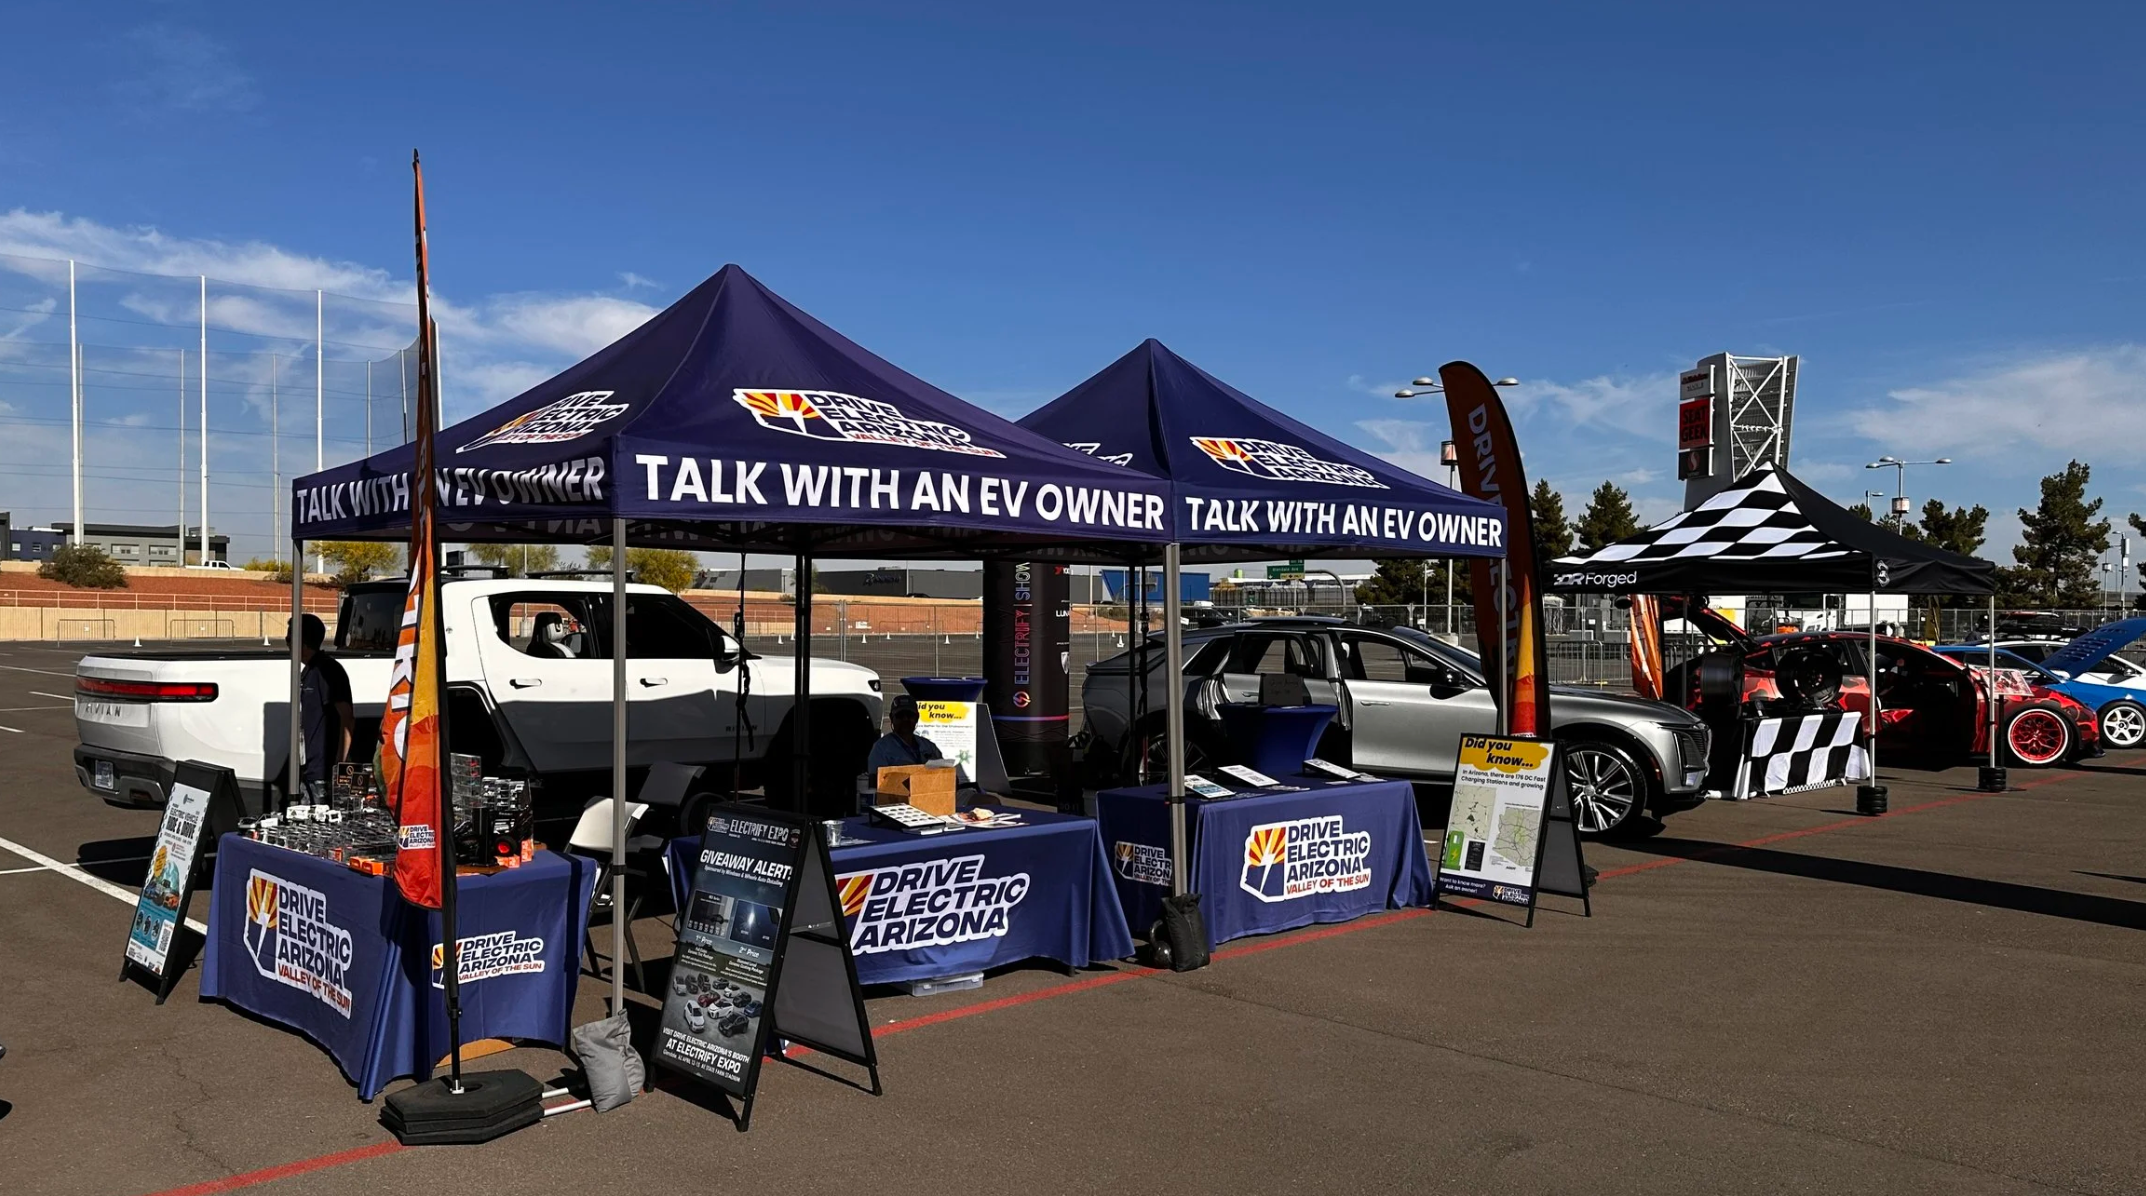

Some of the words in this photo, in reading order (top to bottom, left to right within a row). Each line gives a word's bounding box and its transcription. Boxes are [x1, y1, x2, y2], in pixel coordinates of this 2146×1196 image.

[805, 393, 902, 418] DRIVE
[1683, 405, 1708, 425] SEAT
[826, 408, 967, 441] ELECTRIC
[842, 421, 973, 449] ARIZONA
[1682, 423, 1707, 442] GEEK
[851, 433, 909, 445] VALLEY
[914, 440, 934, 448] OF
[970, 448, 999, 456] SUN
[1240, 440, 1312, 461] DRIVE
[1258, 454, 1374, 479] ELECTRIC
[1279, 467, 1384, 487] ARIZONA
[297, 483, 346, 524] TALK
[349, 472, 409, 517] WITH
[454, 468, 489, 506] EV
[491, 456, 605, 505] OWNER
[636, 454, 768, 505] TALK
[779, 463, 900, 510] WITH
[910, 471, 970, 514] AN
[980, 476, 1028, 518] EV
[1035, 483, 1165, 530] OWNER
[1185, 496, 1260, 532] TALK
[1266, 500, 1336, 534] WITH
[1342, 504, 1379, 537] AN
[1383, 508, 1415, 540] EV
[1418, 511, 1503, 547] OWNER
[1015, 562, 1031, 601] SHOW
[1585, 570, 1637, 588] Forged
[1014, 609, 1031, 685] ELECTRIFY
[918, 702, 927, 710] id
[928, 704, 945, 712] you
[929, 711, 962, 719] know...
[1464, 737, 1486, 750] Did
[1486, 741, 1513, 753] you
[1486, 752, 1534, 768] know...
[1461, 775, 1486, 784] Charging
[1486, 778, 1508, 786] Stations
[729, 819, 769, 837] ELECTRIFY
[767, 825, 790, 842] EXPO
[1287, 820, 1341, 843] DRIVE
[1134, 846, 1164, 859] DRIVE
[1287, 836, 1369, 865] ELECTRIC
[700, 849, 755, 872] GIVEAWAY
[753, 859, 793, 881] ALERT!
[1134, 857, 1171, 869] ELECTR
[1286, 857, 1362, 884] ARIZONA
[870, 859, 980, 896] DRIVE
[1134, 873, 1153, 883] VALLEY
[1286, 879, 1317, 895] VALLEY
[1319, 878, 1335, 889] OF
[1337, 876, 1354, 888] THE
[1354, 874, 1370, 886] SUN
[279, 885, 325, 925] DRIVE
[861, 877, 1027, 923] ELECTRIC
[278, 911, 351, 964] ELECTRIC
[852, 907, 1006, 950] ARIZONA
[461, 940, 542, 962] ELECTRIC
[463, 933, 514, 951] DRIVE
[747, 948, 760, 958] Prize
[278, 938, 343, 989] ARIZONA
[458, 969, 491, 981] VALLEY
[491, 967, 503, 976] OF
[504, 964, 522, 972] THE
[523, 962, 542, 970] SUN
[459, 953, 532, 974] ARIZONA
[278, 964, 312, 985] VALLEY
[311, 978, 322, 992] OF
[322, 982, 337, 1001] THE
[336, 990, 351, 1013] SUN
[663, 1026, 674, 1036] VISIT
[673, 1030, 687, 1041] DRIVE
[686, 1035, 707, 1048] ELECTRIC
[707, 1042, 733, 1057] ARIZONA'S
[732, 1051, 750, 1063] BOOTH
[666, 1037, 677, 1049] AT
[676, 1041, 718, 1065] ELECTRIFY
[717, 1055, 742, 1074] EXPO
